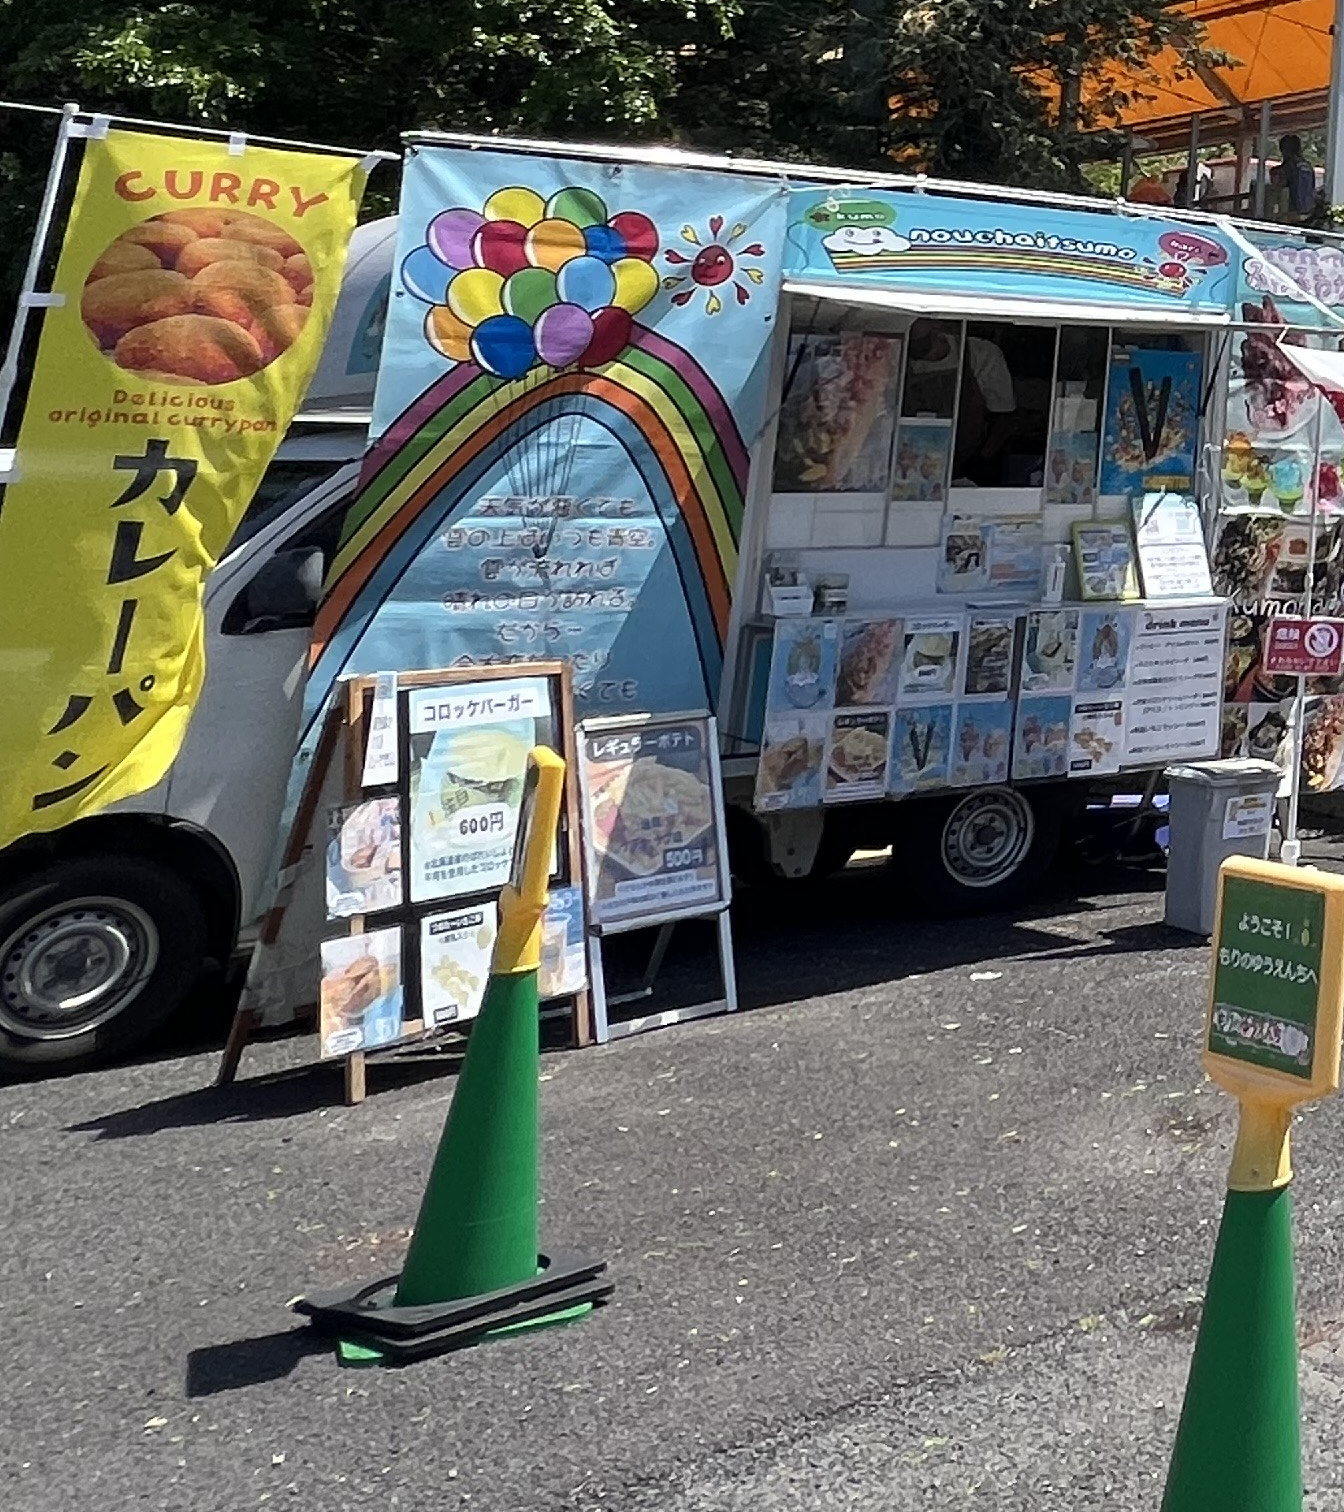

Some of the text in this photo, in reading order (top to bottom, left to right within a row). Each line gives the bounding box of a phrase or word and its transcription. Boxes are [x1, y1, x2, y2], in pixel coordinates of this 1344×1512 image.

[114, 168, 330, 218] CURRY
[908, 227, 1138, 262] nouchaitsumo
[112, 389, 236, 413] Delicious
[48, 407, 278, 434] original currypan
[31, 437, 200, 811] カレーパン
[423, 693, 534, 723] コロッケバーガー
[593, 731, 695, 758] レギュラーポテト
[459, 810, 505, 836] 600円
[1219, 945, 1319, 985] もりのゆうえんちへ
